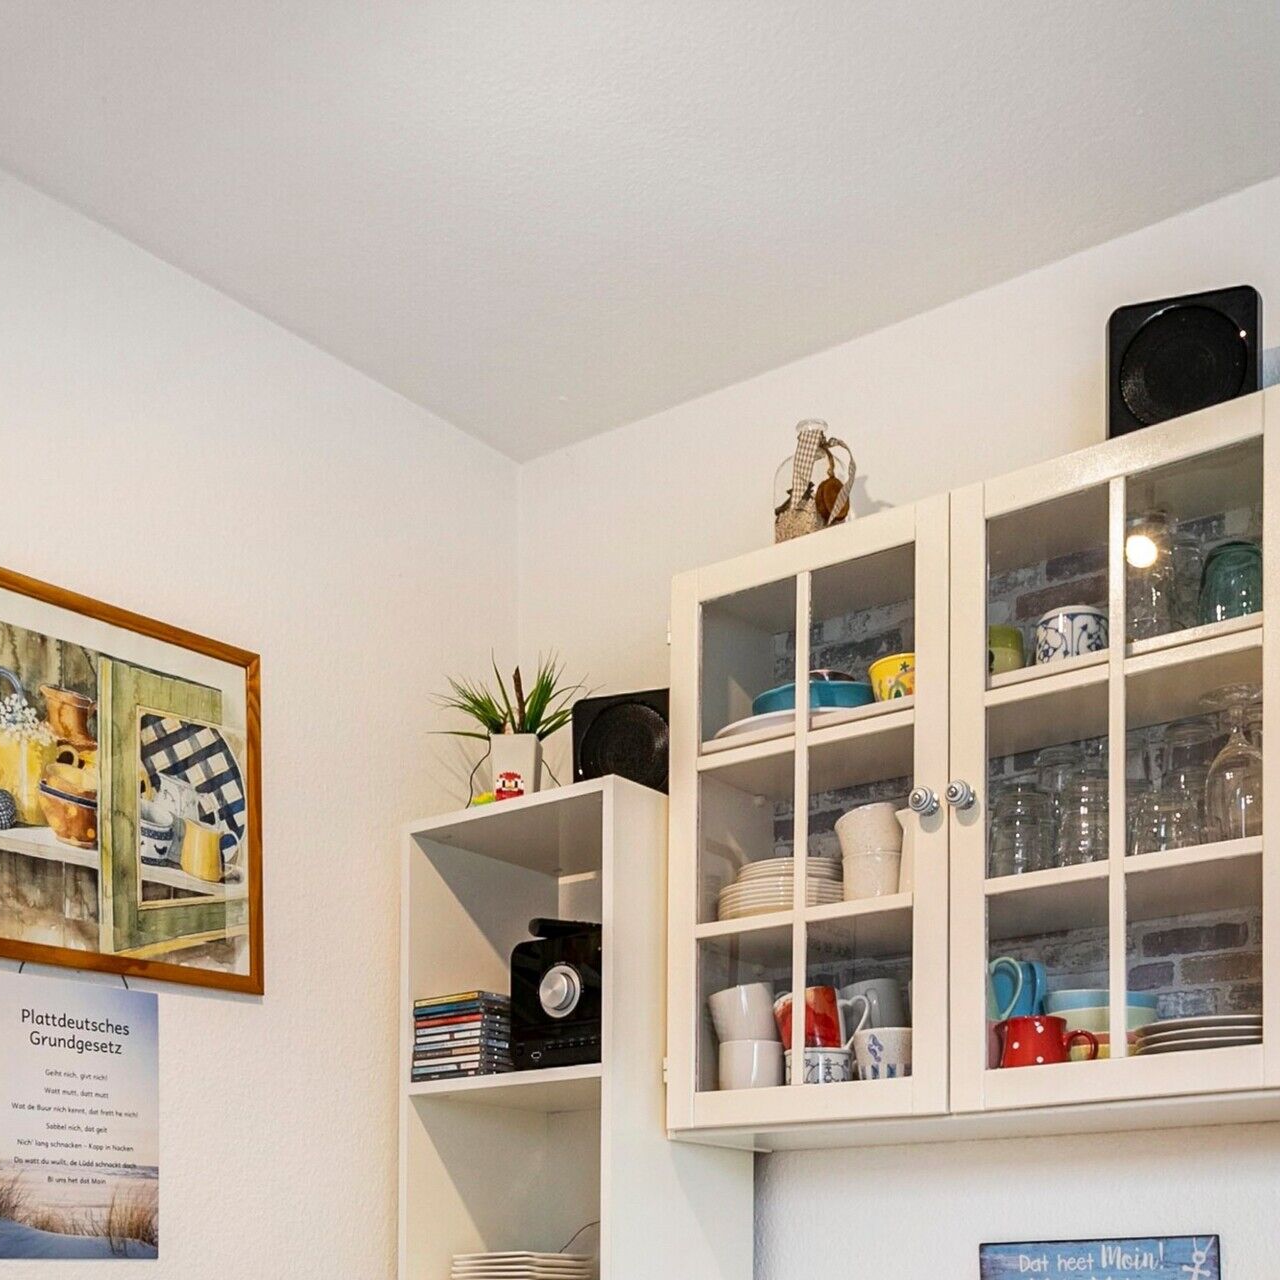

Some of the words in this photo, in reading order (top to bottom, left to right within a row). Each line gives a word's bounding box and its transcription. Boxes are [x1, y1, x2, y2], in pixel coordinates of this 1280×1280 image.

[21, 1008, 130, 1036] Plattdeutsches
[29, 1030, 122, 1055] Grundgesetz
[1019, 1255, 1049, 1273] Dat
[1057, 1253, 1094, 1272] heet
[1101, 1242, 1164, 1270] Moin!
